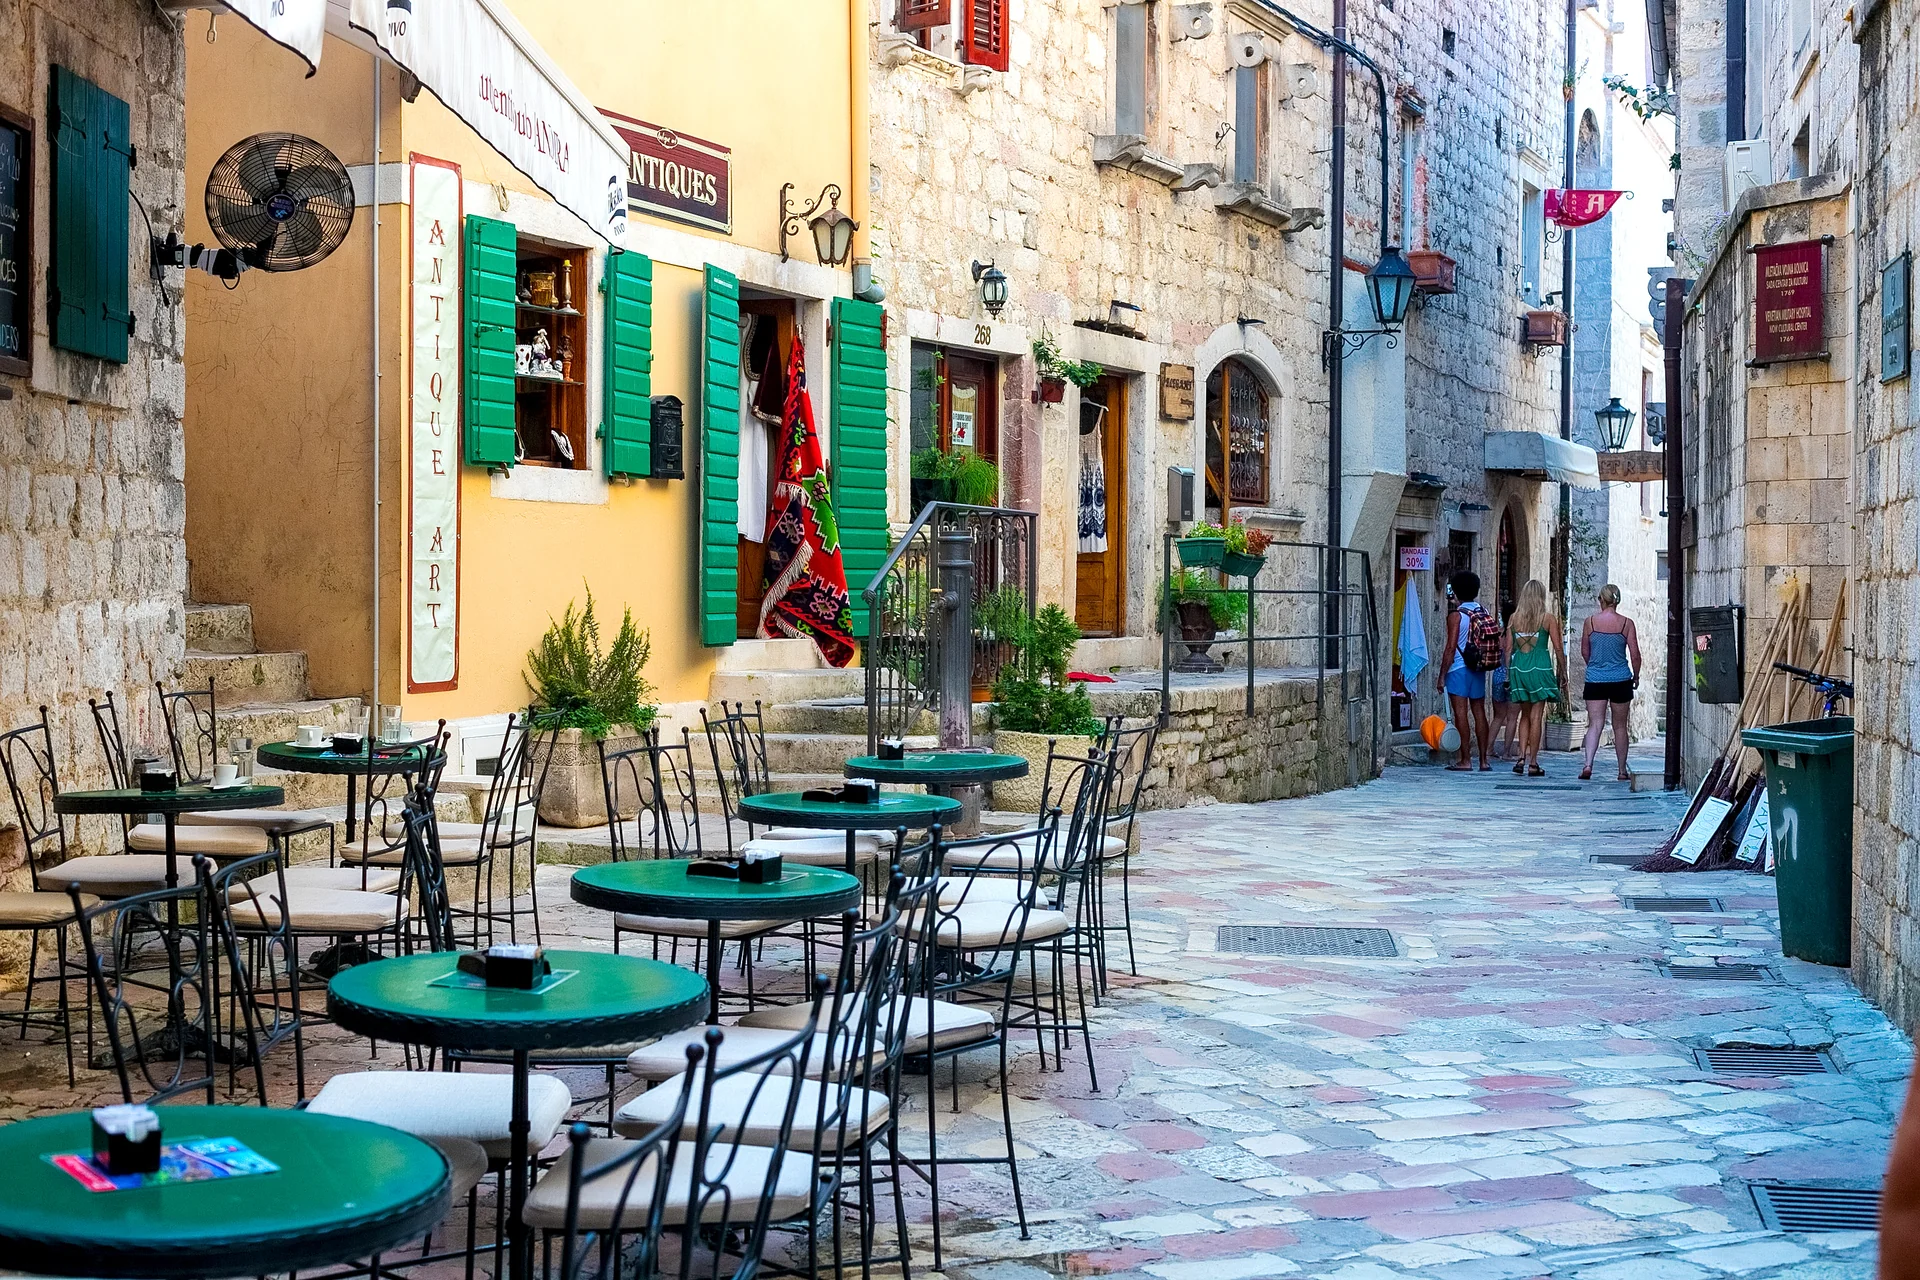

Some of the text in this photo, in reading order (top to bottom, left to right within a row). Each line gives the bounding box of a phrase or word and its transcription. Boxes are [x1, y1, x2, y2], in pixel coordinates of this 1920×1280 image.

[1796, 306, 1812, 318] HOSPITAL
[974, 323, 991, 346] 268
[1795, 321, 1808, 331] CENTER
[427, 219, 448, 477] ANTIQUE
[1600, 460, 1664, 477] TRIU
[1406, 557, 1424, 568] 30%
[427, 526, 444, 630] ART
